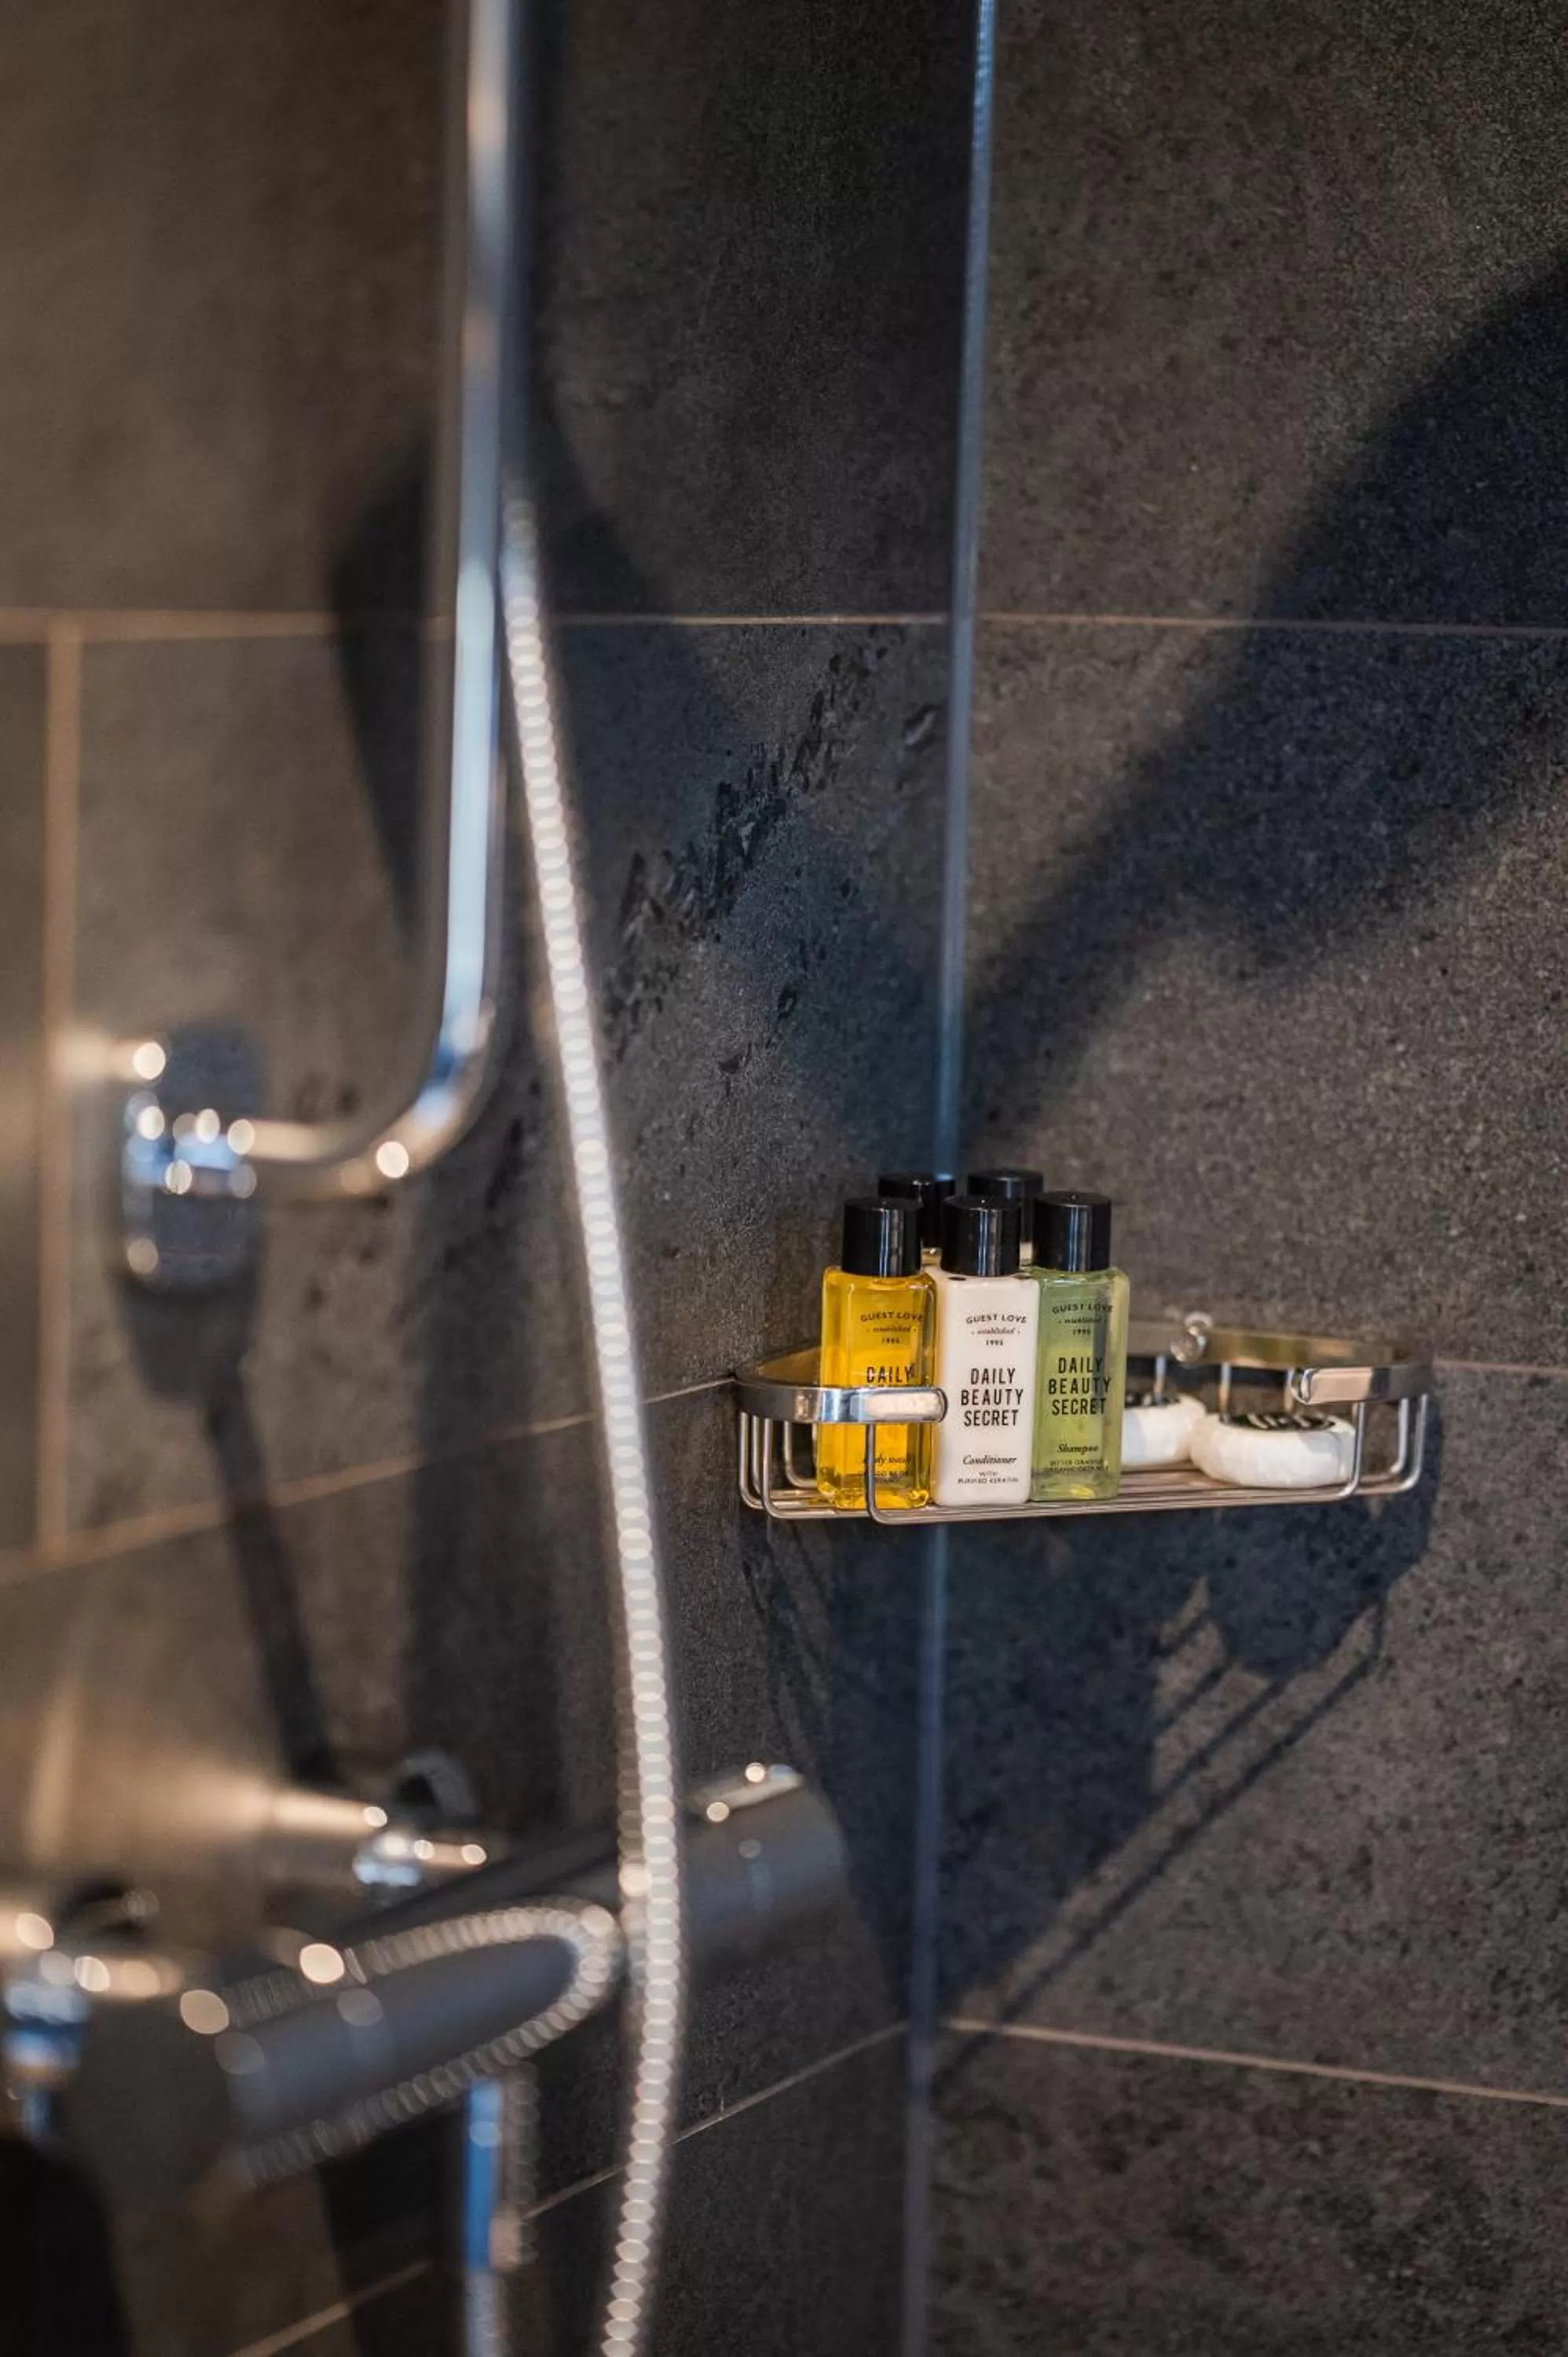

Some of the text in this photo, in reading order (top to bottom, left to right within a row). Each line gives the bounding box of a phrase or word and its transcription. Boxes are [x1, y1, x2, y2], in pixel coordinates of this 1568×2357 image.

[860, 1311, 893, 1322] GUEST
[1052, 1303, 1083, 1314] GUEST
[965, 1314, 1027, 1324] GUEST LOVE
[1058, 1357, 1103, 1373] DAILY
[866, 1365, 915, 1384] DAILY
[970, 1368, 1016, 1385] DAILY
[1048, 1376, 1112, 1395] BEAUTY
[961, 1388, 1024, 1406] BEAUTY
[1051, 1398, 1107, 1416] SECRET
[964, 1409, 1019, 1427] SECRET
